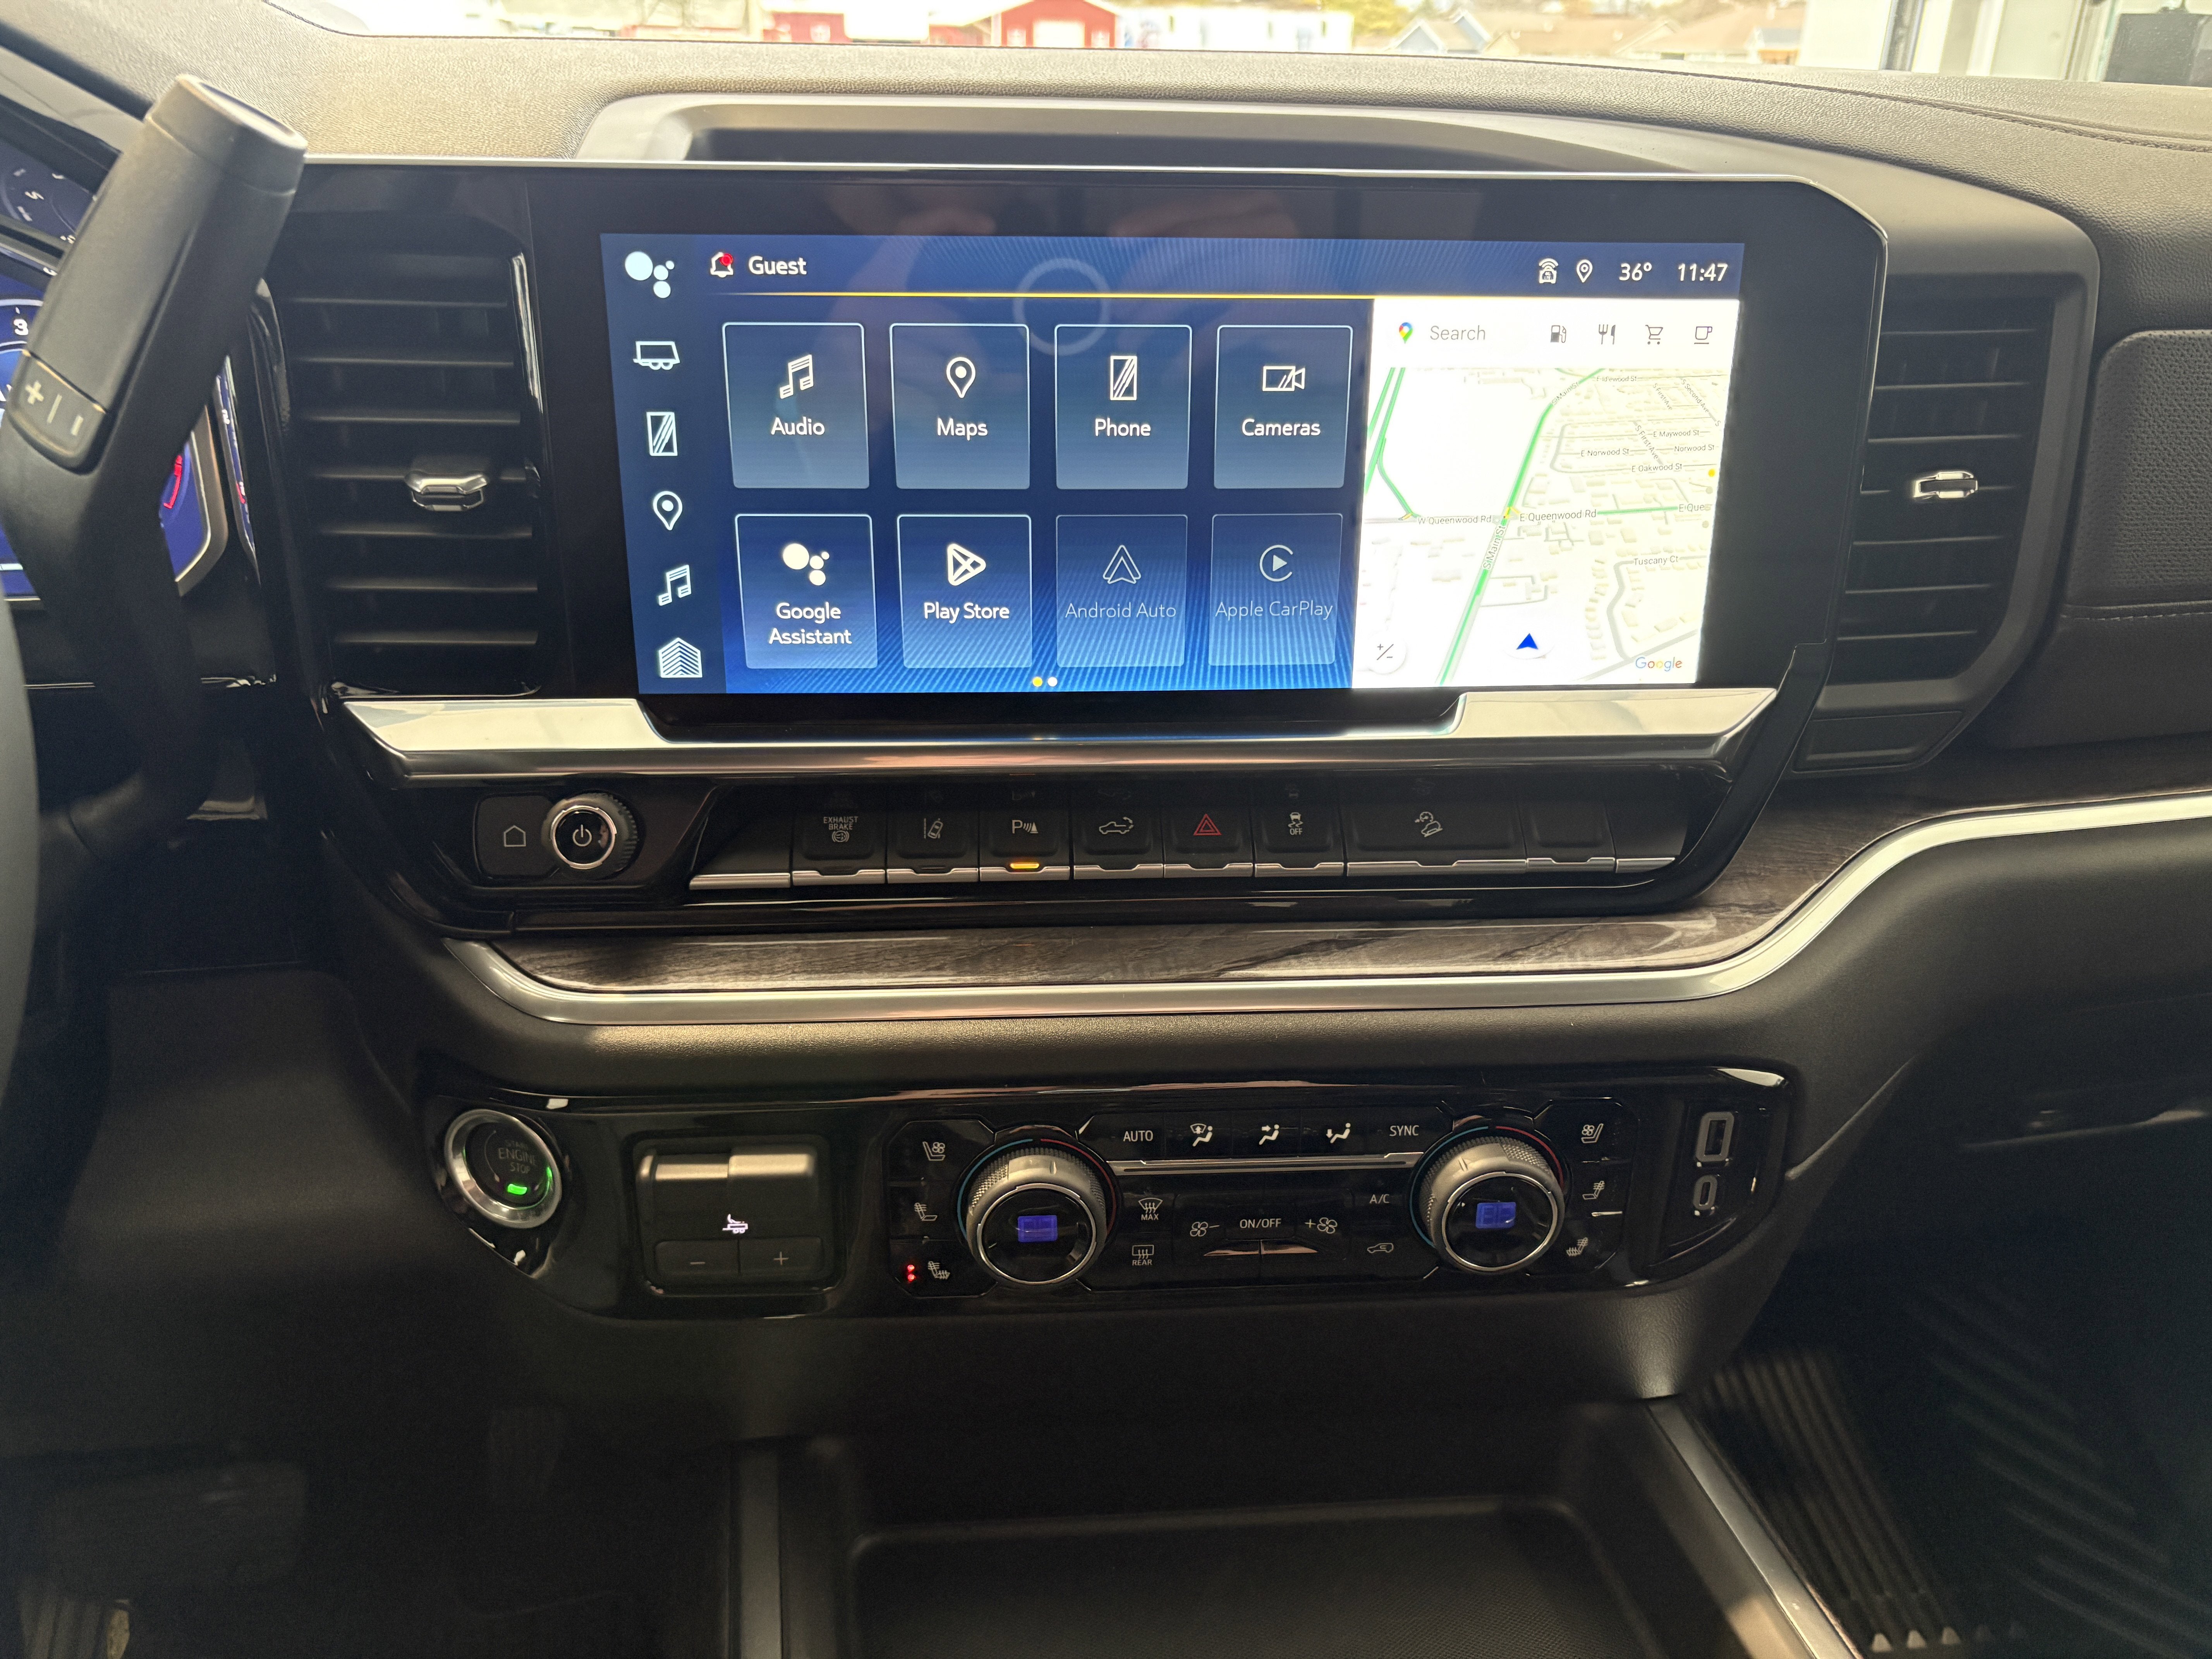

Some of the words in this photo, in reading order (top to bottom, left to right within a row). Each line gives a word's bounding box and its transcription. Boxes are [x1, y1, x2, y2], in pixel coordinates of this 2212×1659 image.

[748, 256, 807, 275] Guest
[1678, 263, 1728, 282] 11:47
[1429, 326, 1486, 341] Search
[1685, 383, 1702, 403] Second
[771, 417, 825, 436] Audio
[937, 418, 988, 441] Maps
[1094, 418, 1151, 437] Phone
[1241, 419, 1321, 436] Cameras
[1638, 463, 1673, 472] Oakwood
[1429, 516, 1478, 525] Queenwood
[1481, 515, 1491, 523] Rd
[1520, 514, 1525, 522] E
[1528, 512, 1582, 522] Queenwood
[1585, 509, 1597, 518] Rd
[1486, 538, 1501, 561] Main
[1633, 558, 1668, 566] Tuscany
[776, 602, 842, 624] Google
[924, 603, 958, 623] Play
[963, 603, 1010, 619] Store
[1065, 603, 1132, 618] Android
[1136, 603, 1177, 618] Auto
[1215, 601, 1264, 621] Apple
[1269, 600, 1334, 620] CarPlay
[769, 628, 852, 645] Assistant
[1635, 656, 1683, 671] Google
[1012, 819, 1023, 834] P
[1123, 1130, 1153, 1142] AUTO
[1389, 1125, 1419, 1137] SYNC
[498, 1147, 537, 1166] ENGINE
[1369, 1194, 1390, 1204] A/C
[1240, 1218, 1282, 1229] ON/OFF
